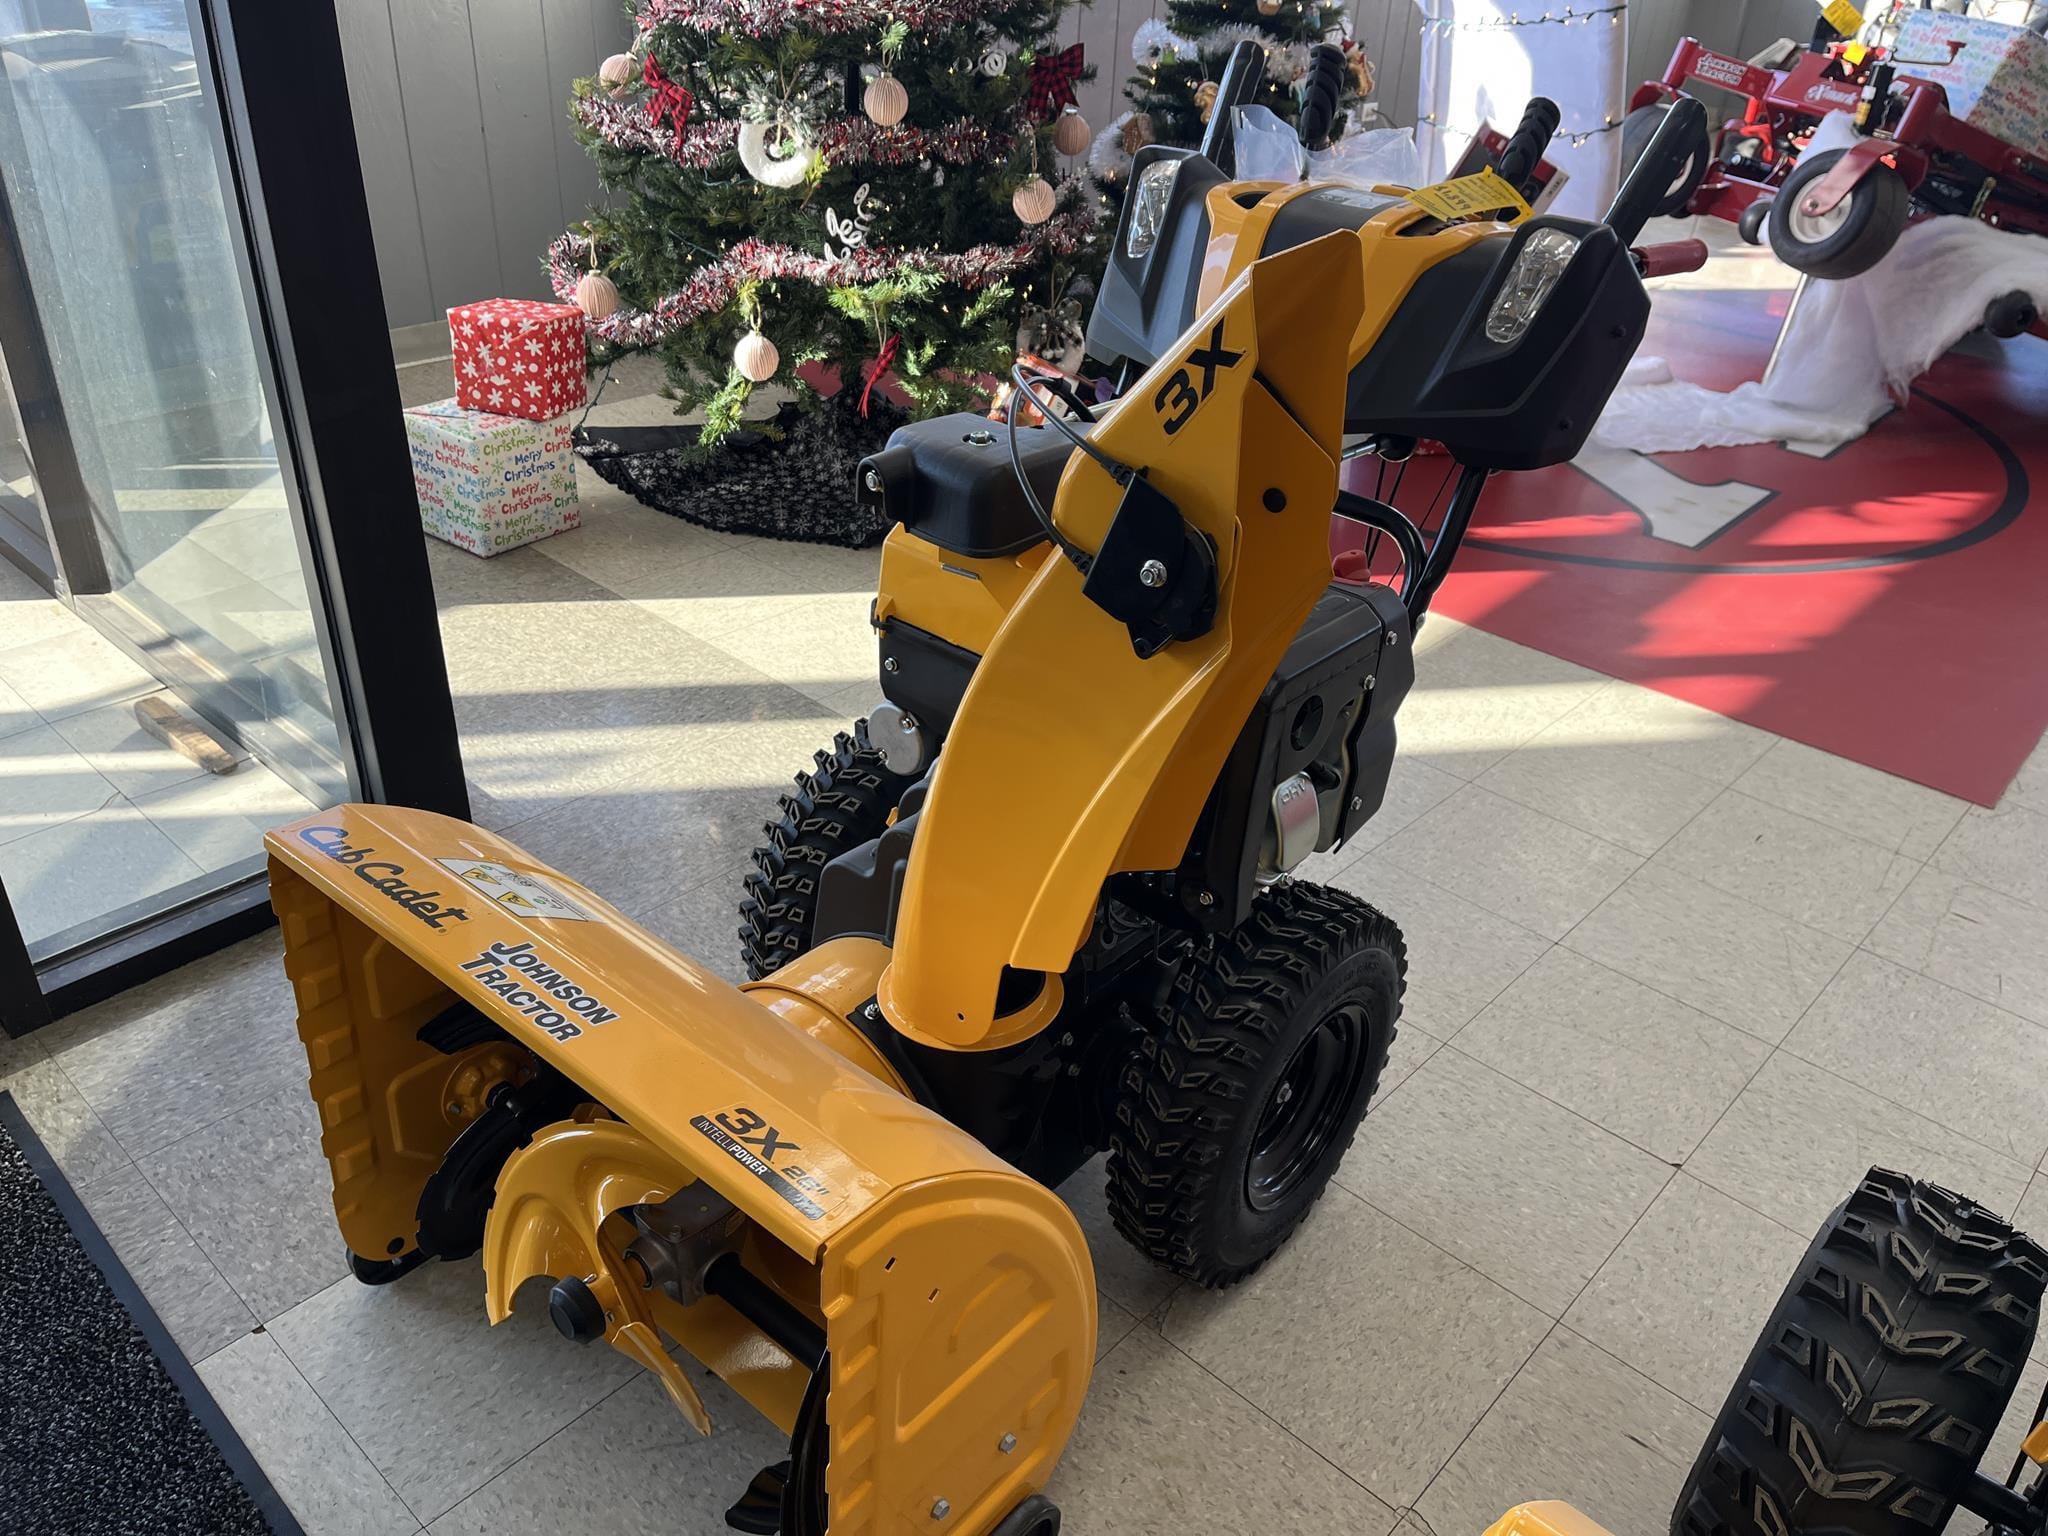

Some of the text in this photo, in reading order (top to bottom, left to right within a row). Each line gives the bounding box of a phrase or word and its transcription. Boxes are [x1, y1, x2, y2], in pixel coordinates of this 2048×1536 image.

[1155, 315, 1244, 435] 3X
[442, 440, 466, 457] Merry
[483, 434, 536, 456] Christmas
[435, 450, 480, 475] Christmas
[514, 449, 543, 465] Merry
[464, 474, 491, 490] Merry
[504, 460, 556, 482] Christmas
[457, 483, 506, 503] Christmas
[511, 481, 540, 499] Merry
[453, 499, 476, 518] Merry
[501, 492, 553, 515] Christmas
[446, 508, 492, 532] Christmas
[505, 513, 533, 530] Merry
[453, 529, 477, 548] Merry
[494, 523, 546, 547] Christmas
[299, 826, 374, 870] Cub
[354, 861, 470, 930] Cadet
[489, 941, 621, 1026] JOHNSON
[459, 951, 583, 1045] TRACTOR
[714, 1107, 801, 1162] 3X
[697, 1119, 769, 1176] INTELLIPOWER
